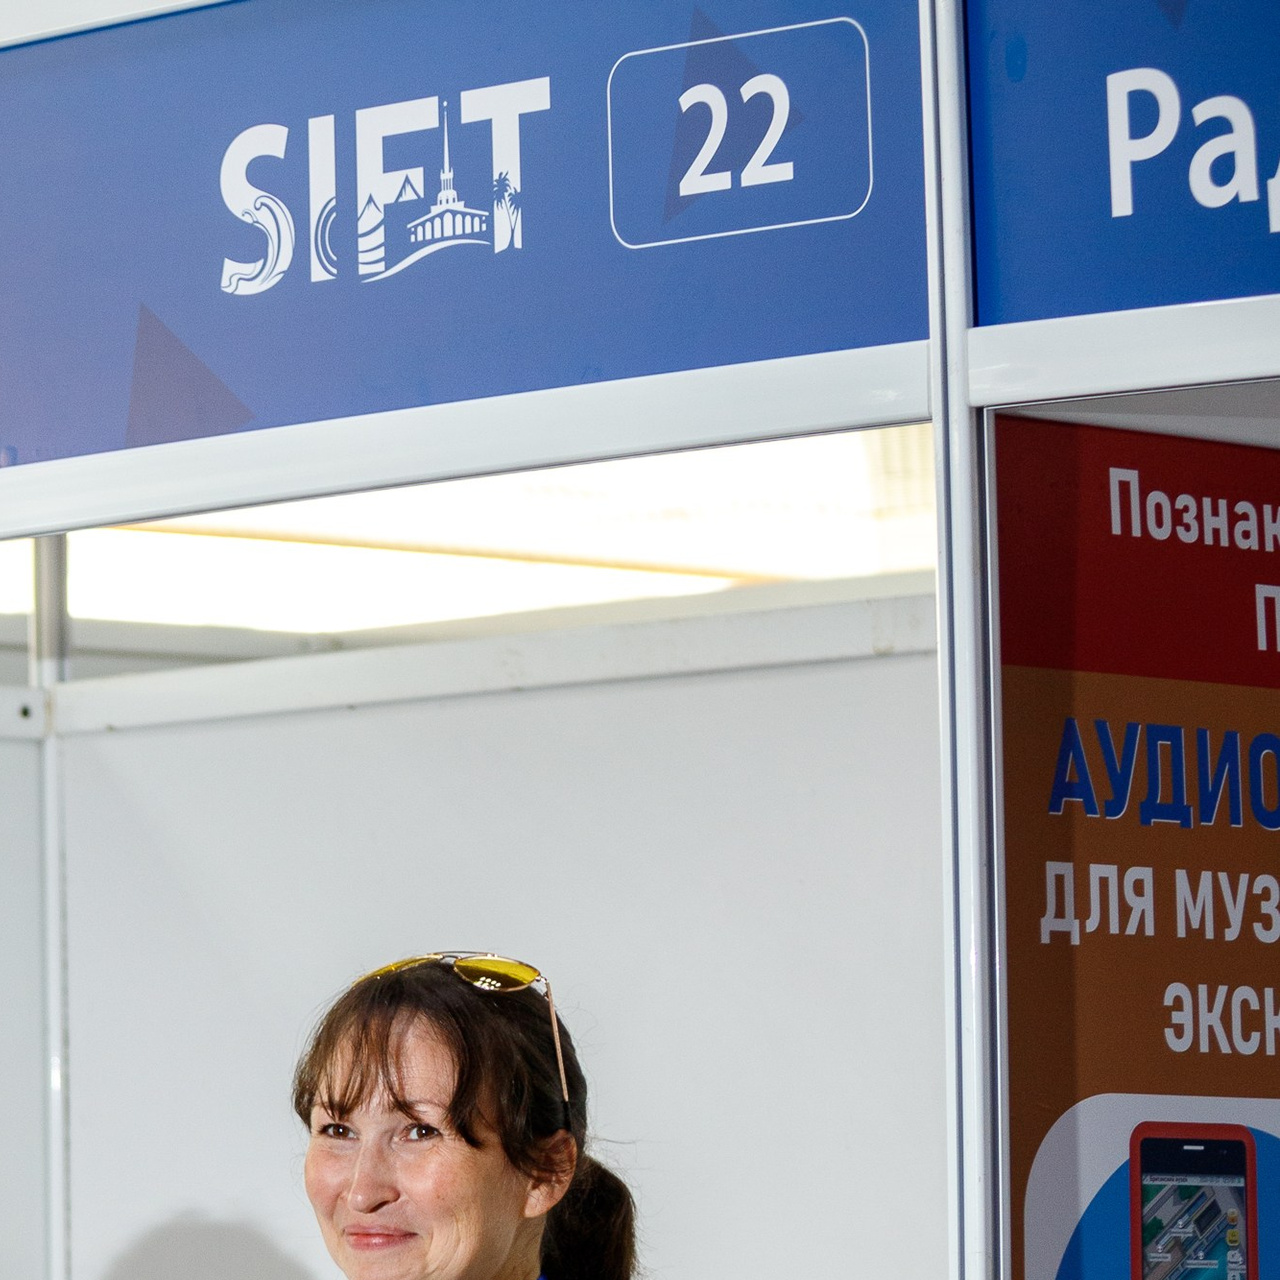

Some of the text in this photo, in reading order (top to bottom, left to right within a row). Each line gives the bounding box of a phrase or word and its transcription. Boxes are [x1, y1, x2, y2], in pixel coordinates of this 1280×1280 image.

[219, 76, 552, 297] SIFT
[678, 73, 797, 197] 22
[1040, 861, 1280, 946] ДЛЯ МУЗ
